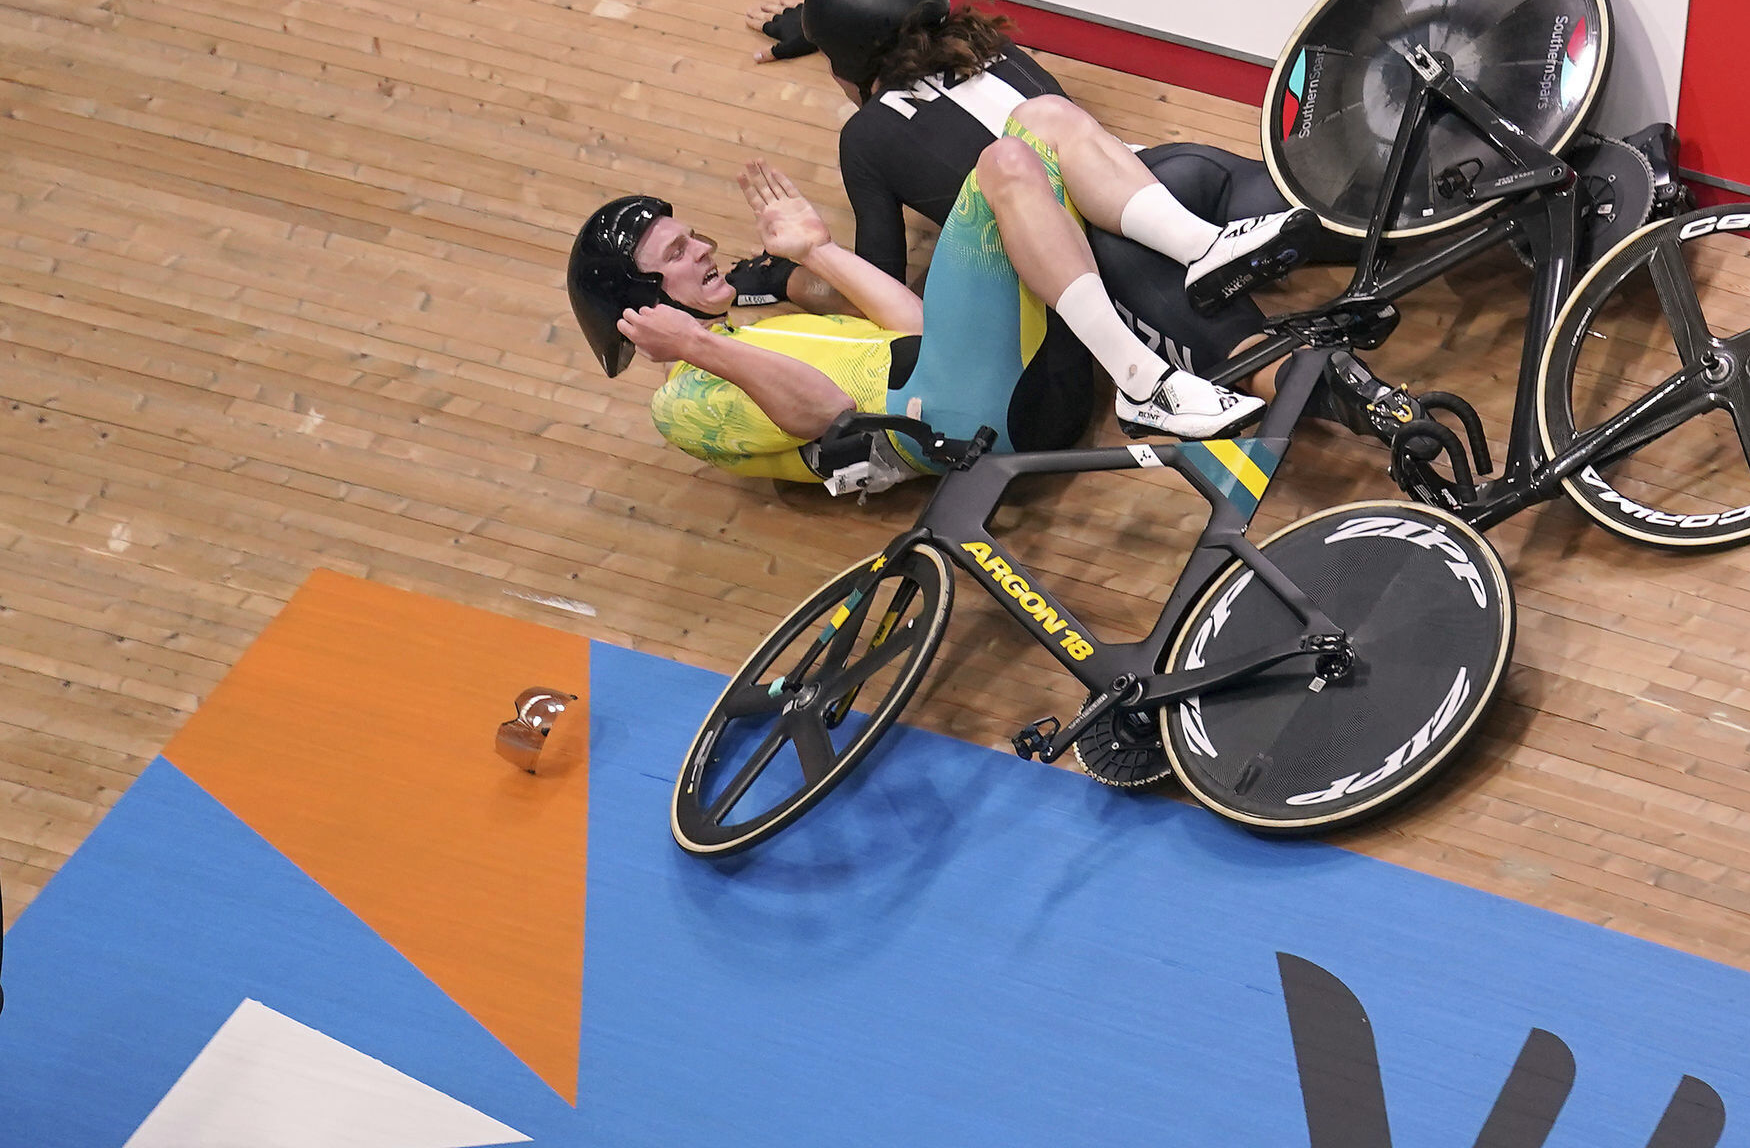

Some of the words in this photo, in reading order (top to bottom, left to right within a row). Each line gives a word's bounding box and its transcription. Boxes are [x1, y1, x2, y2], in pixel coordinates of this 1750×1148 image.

[1298, 44, 1329, 140] SouthernSpars
[1537, 15, 1570, 111] SouthernSpars
[1137, 408, 1162, 422] BONT
[960, 541, 1068, 636] ARGON
[1059, 628, 1095, 662] 18
[1323, 515, 1489, 611] ZIPP
[1284, 665, 1472, 807] ZIPP
